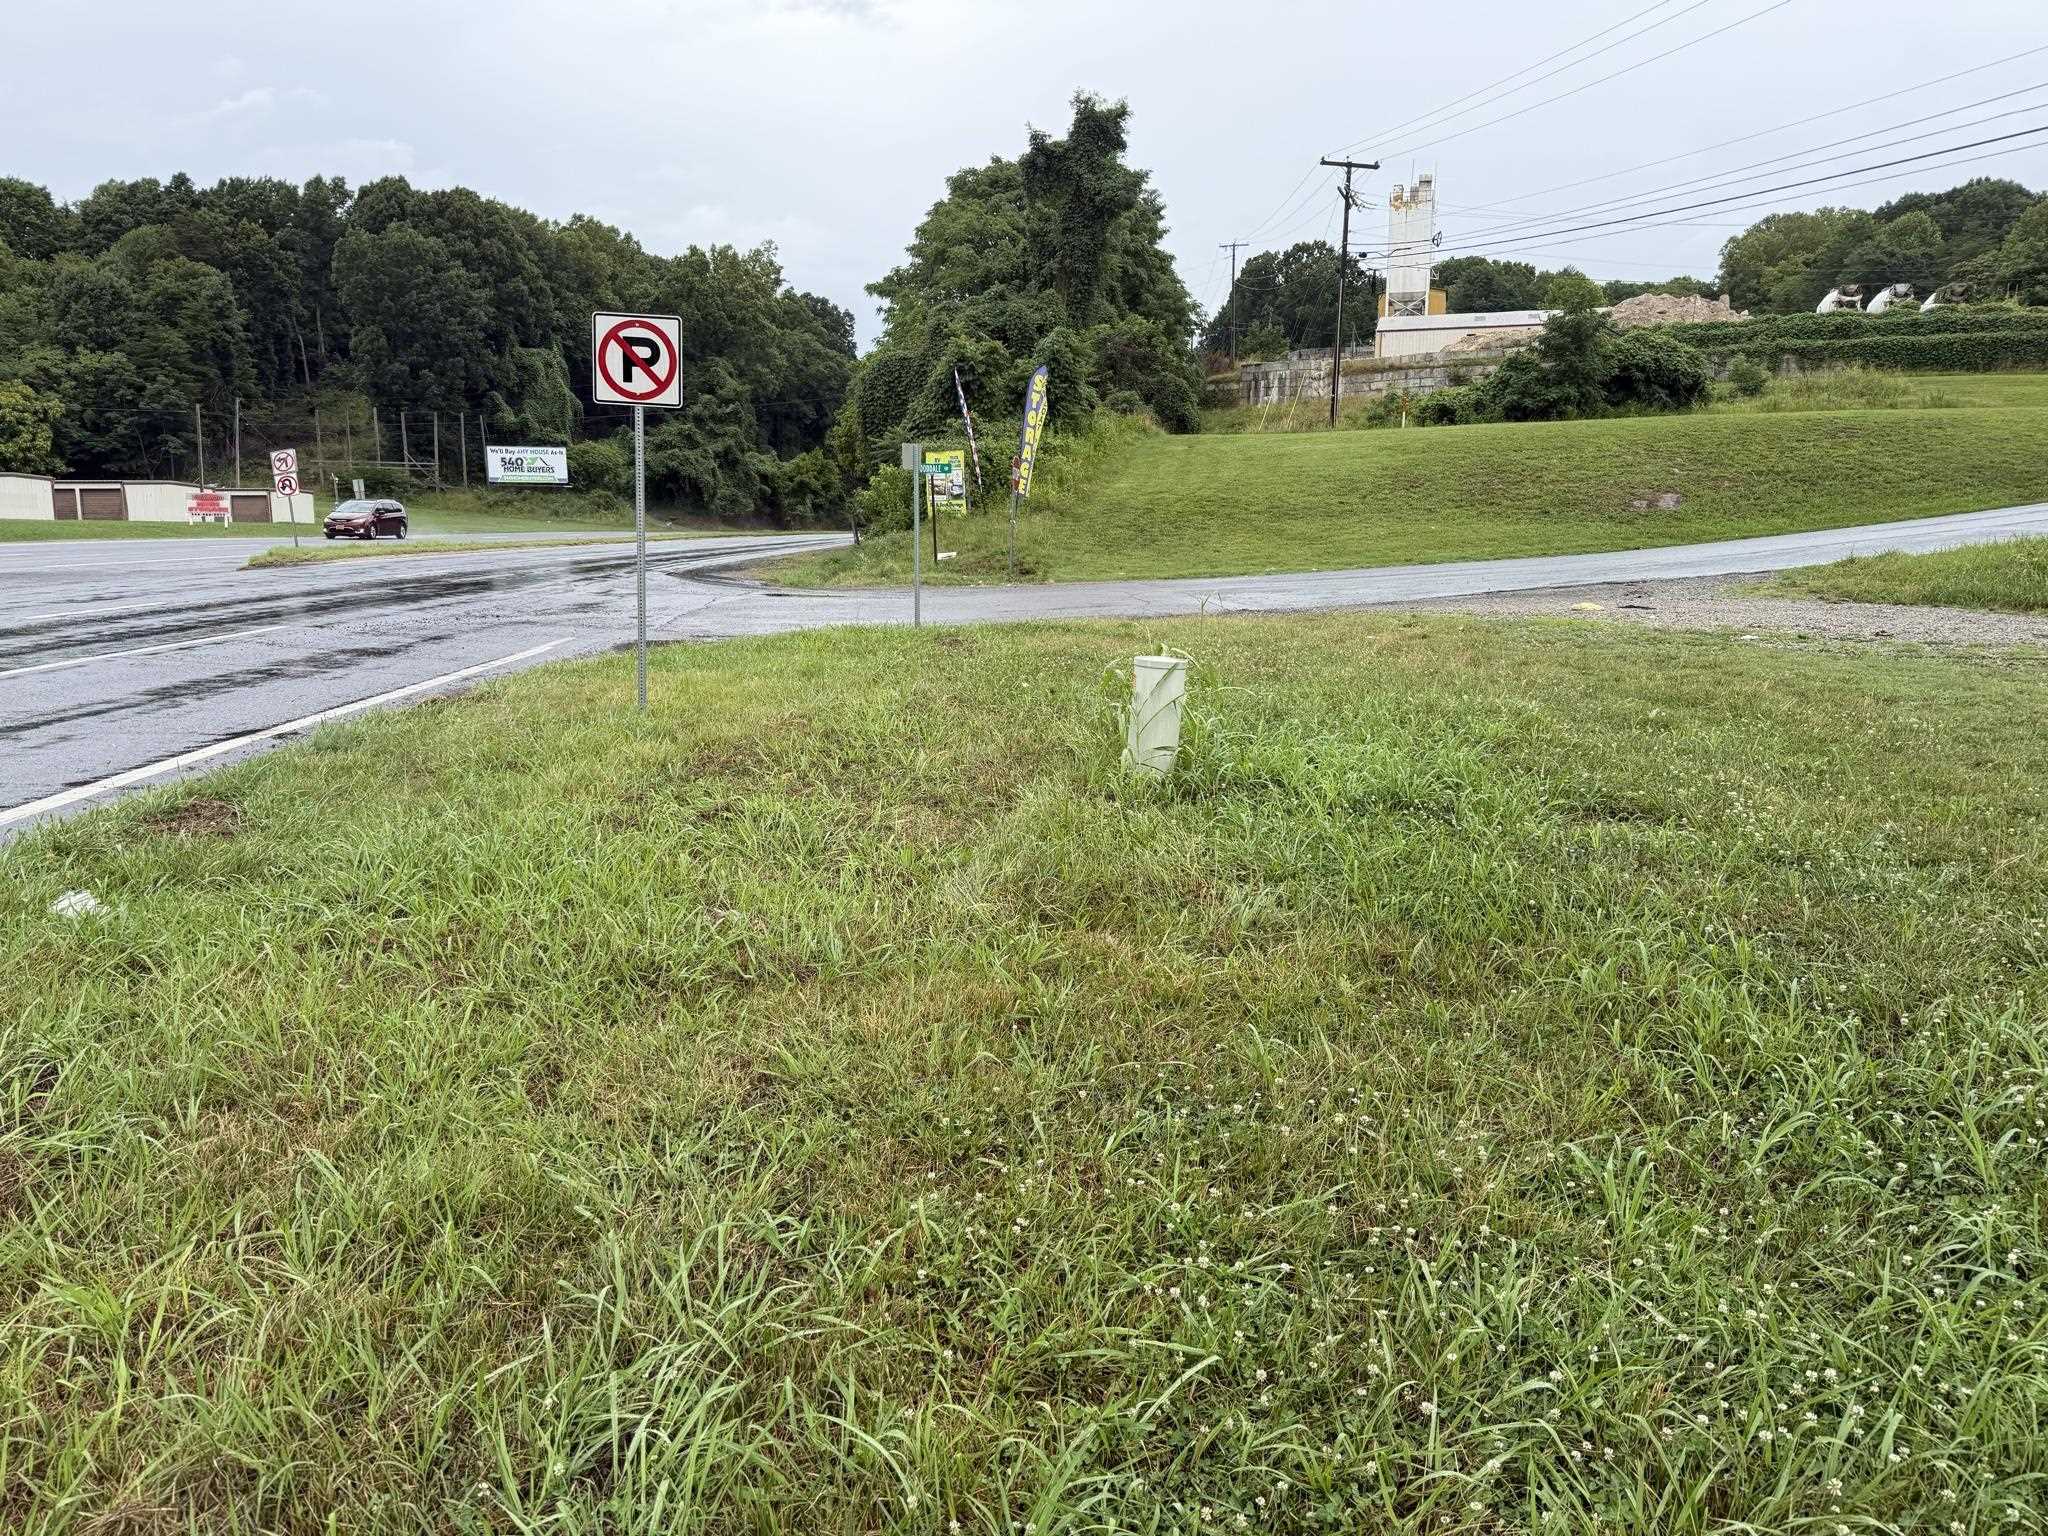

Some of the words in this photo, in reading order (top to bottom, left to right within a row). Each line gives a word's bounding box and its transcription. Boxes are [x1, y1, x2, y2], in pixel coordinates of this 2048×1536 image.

[1018, 374, 1044, 495] STORAGE
[505, 448, 516, 456] Buy
[500, 457, 524, 467] 540
